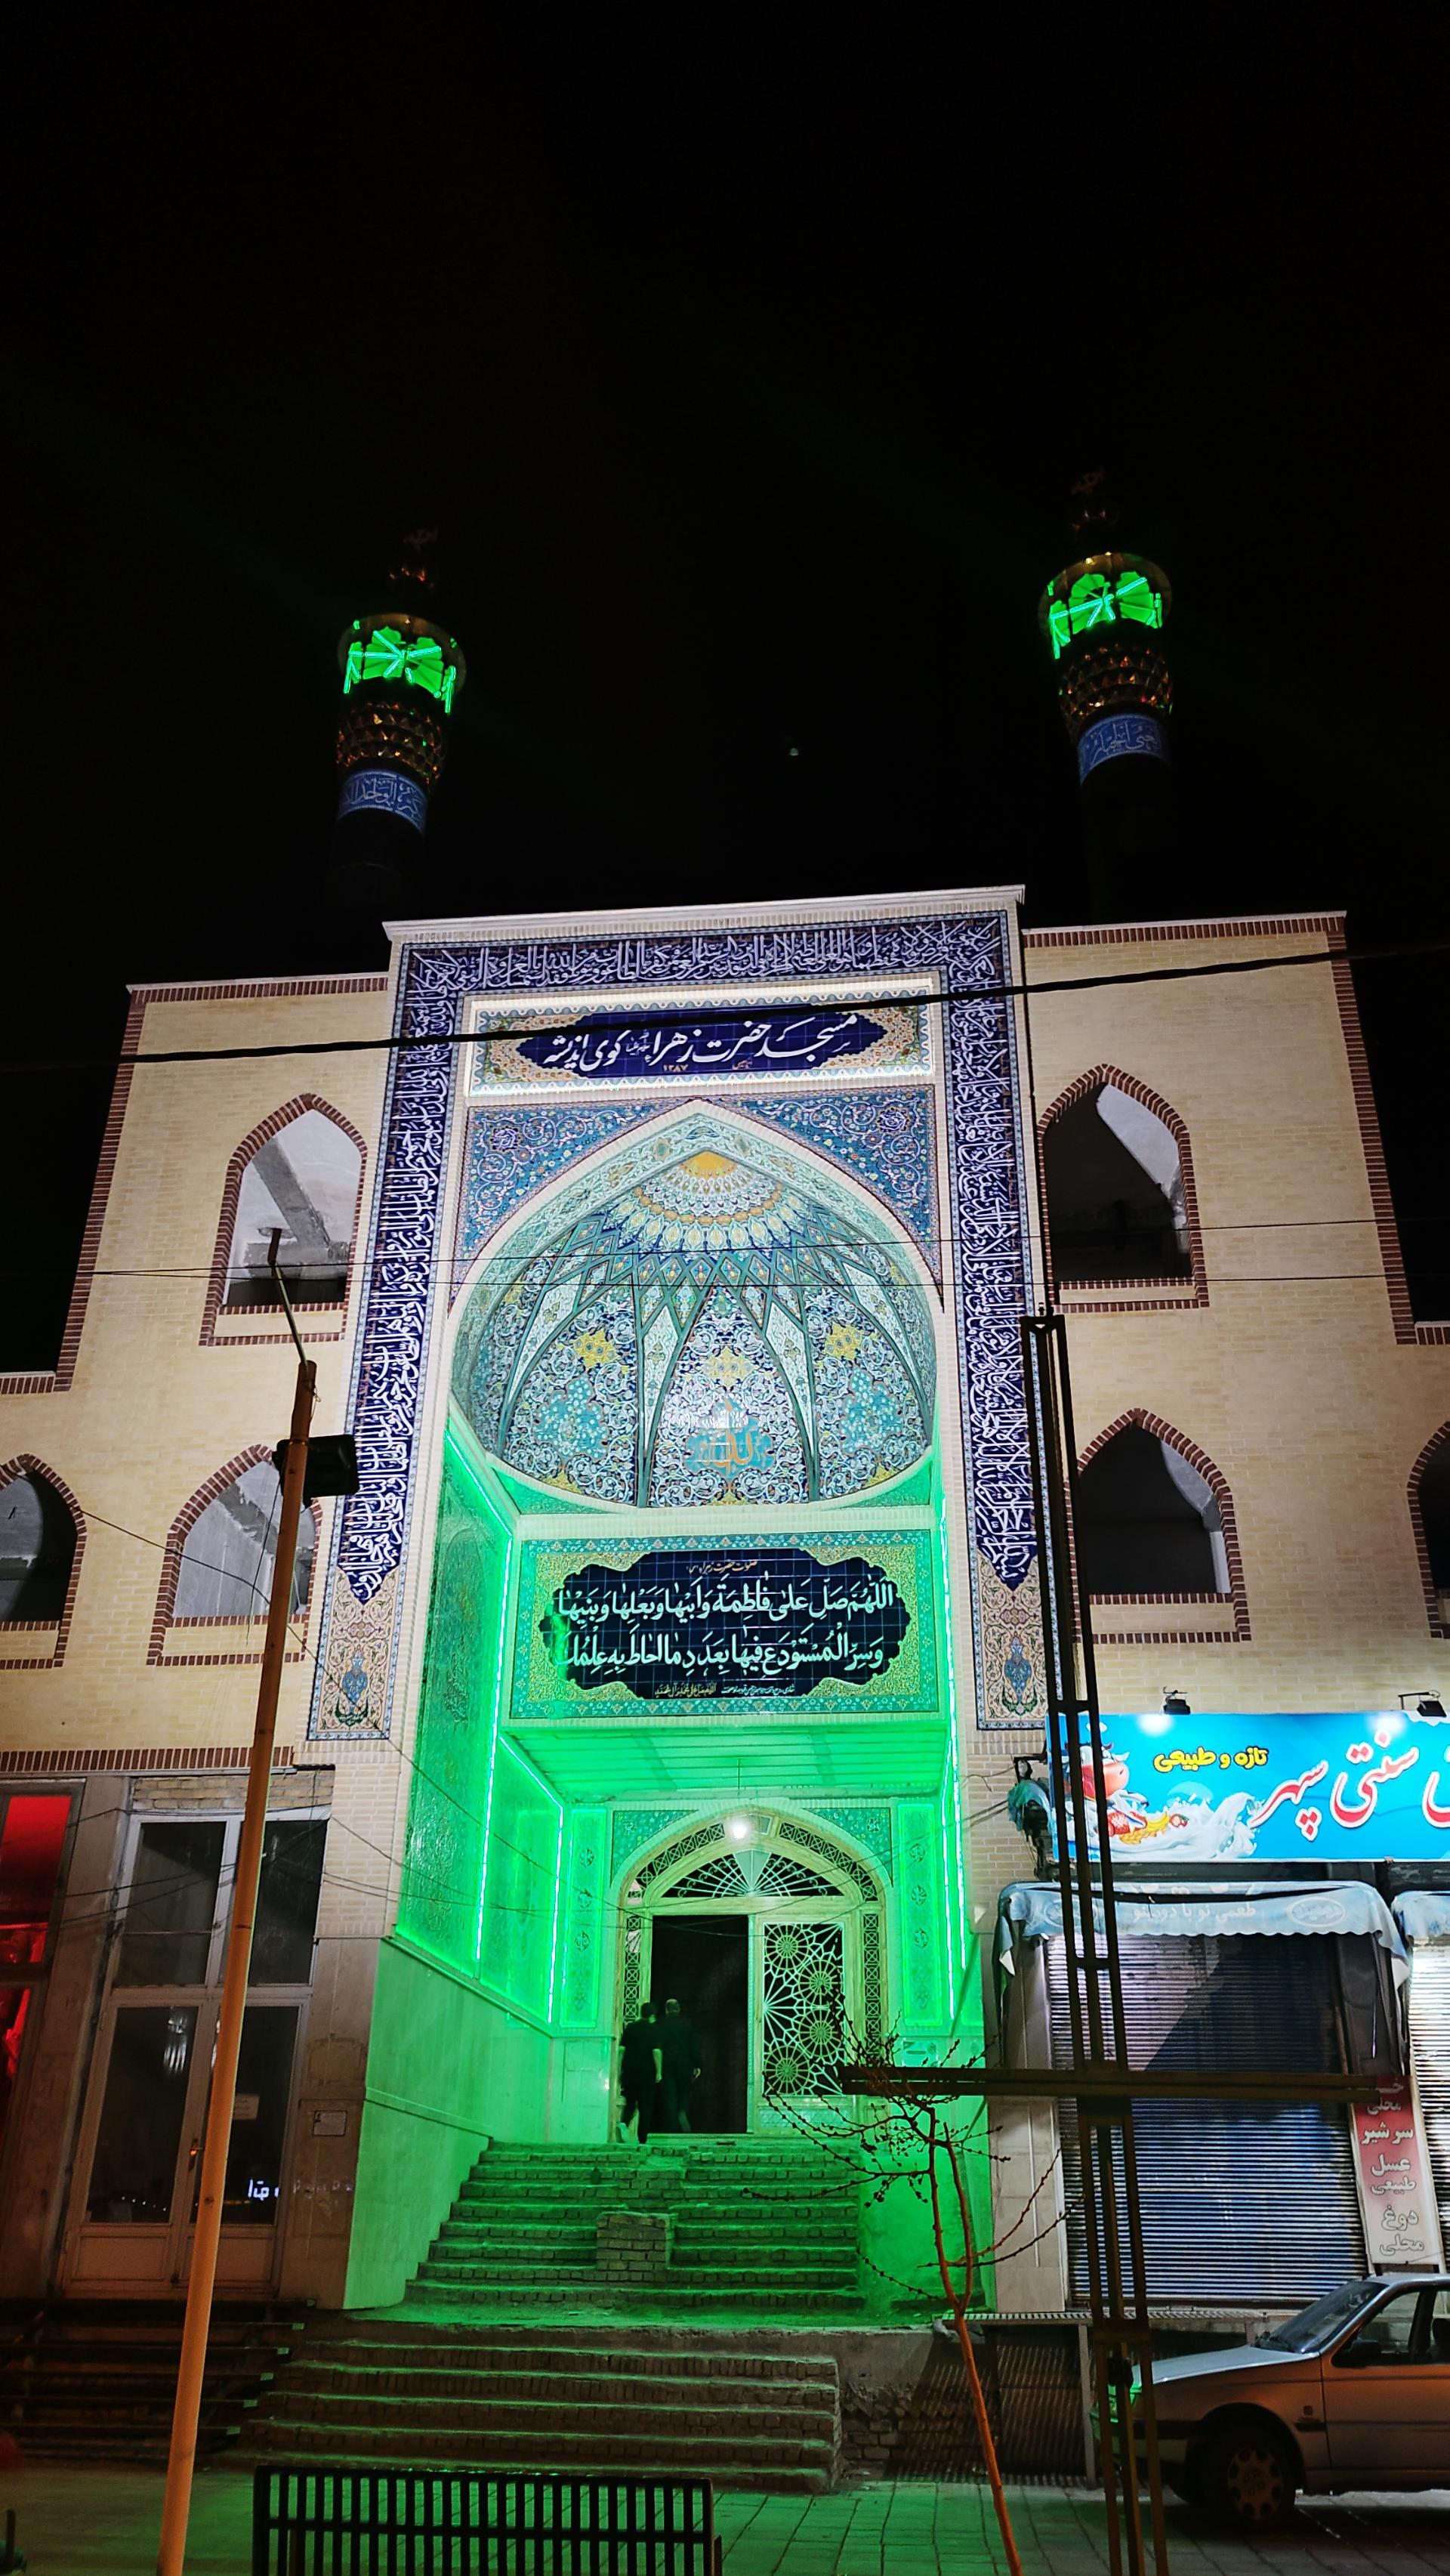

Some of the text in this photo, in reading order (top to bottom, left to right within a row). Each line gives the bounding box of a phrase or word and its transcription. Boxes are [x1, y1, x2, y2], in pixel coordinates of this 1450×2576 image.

[692, 1021, 773, 1064] حضرت
[754, 1015, 858, 1062] مسجد
[1152, 1744, 1270, 1773] تازه و طبیعی
[1330, 1730, 1420, 1828] سنتی
[1248, 1759, 1329, 1842] سپهر
[1367, 2097, 1402, 2115] محلی
[1371, 2153, 1411, 2176] عسل
[1371, 2176, 1417, 2195] طبیعی
[1381, 2204, 1419, 2231] دوغ
[1380, 2233, 1424, 2257] محلی
